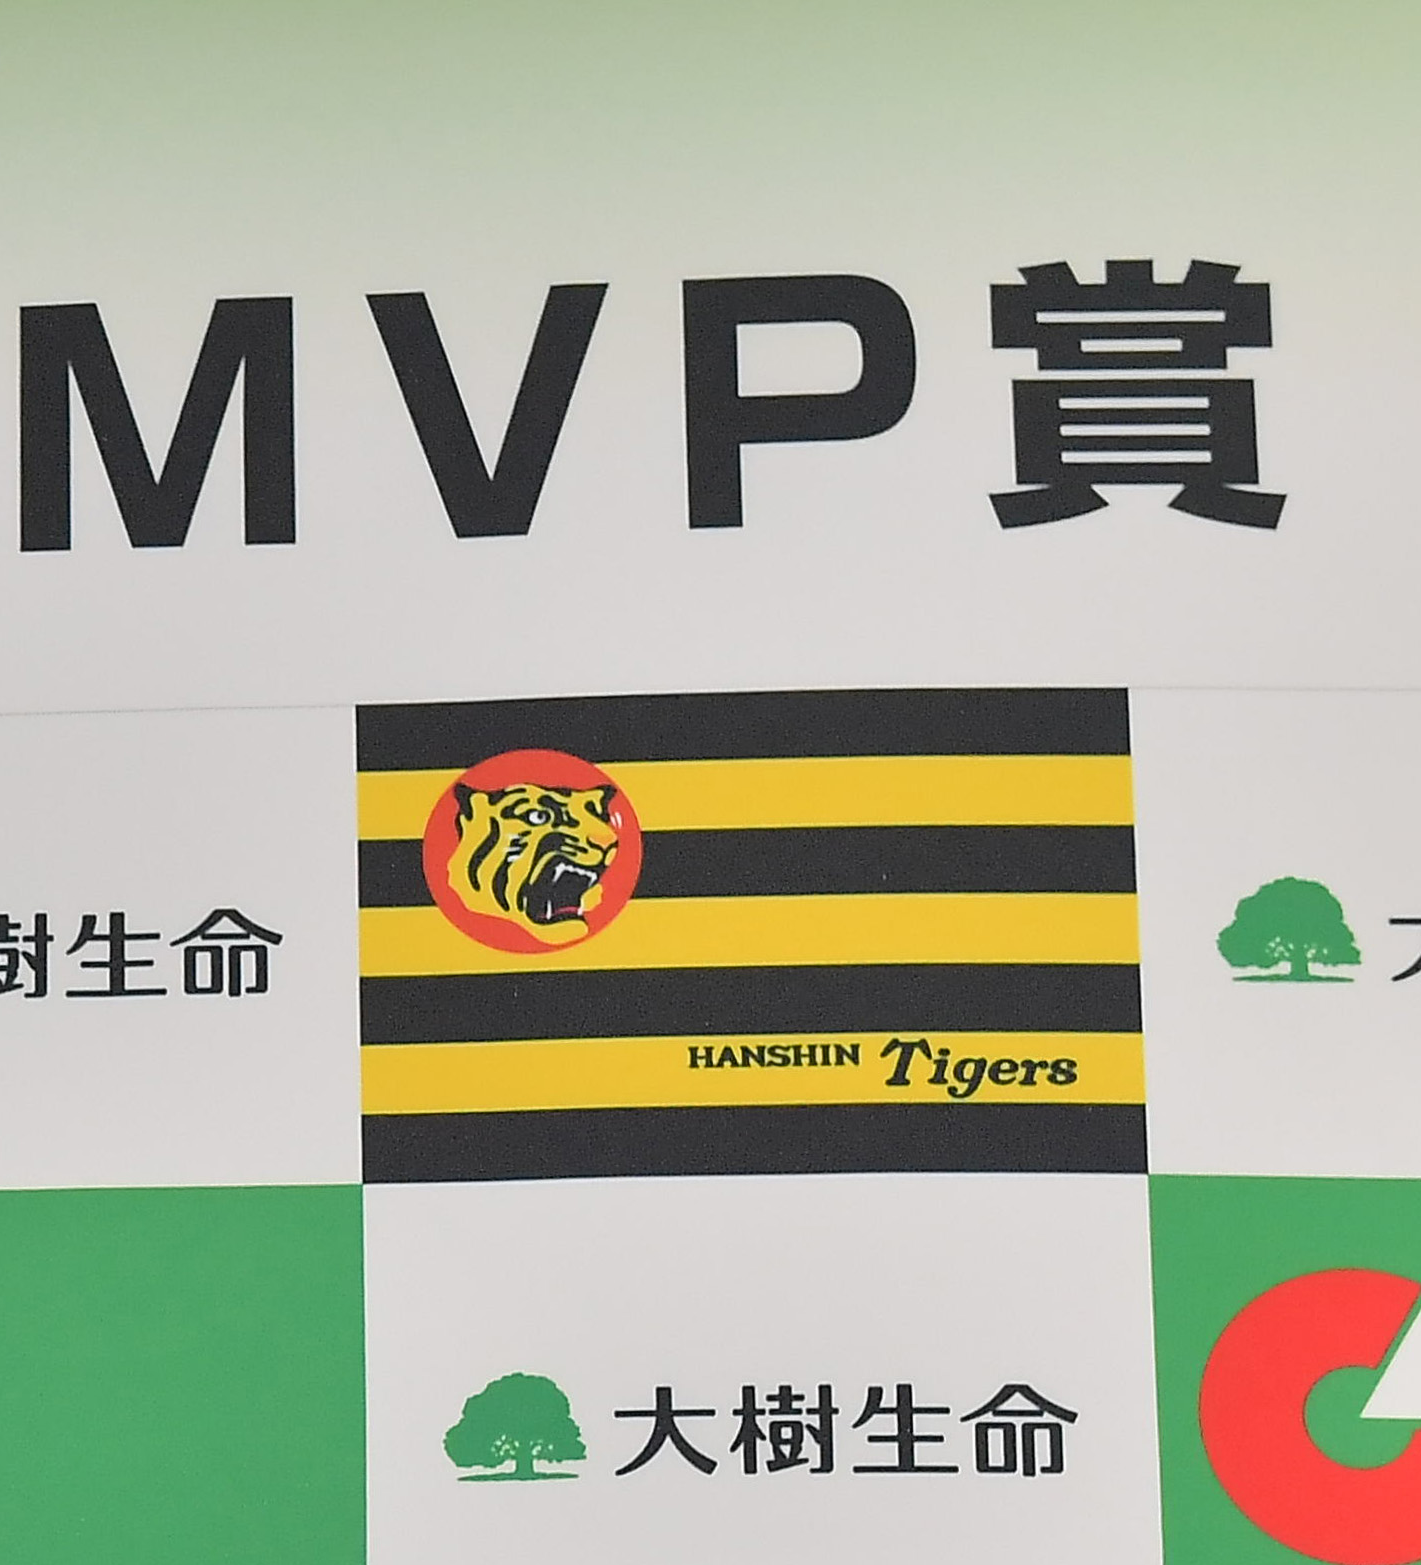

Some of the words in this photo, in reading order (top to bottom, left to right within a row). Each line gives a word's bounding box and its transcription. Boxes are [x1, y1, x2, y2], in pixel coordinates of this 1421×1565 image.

[687, 1042, 861, 1070] HANSHIN
[880, 1038, 1079, 1099] Tigers
[613, 1382, 1079, 1478] 大樹生命
